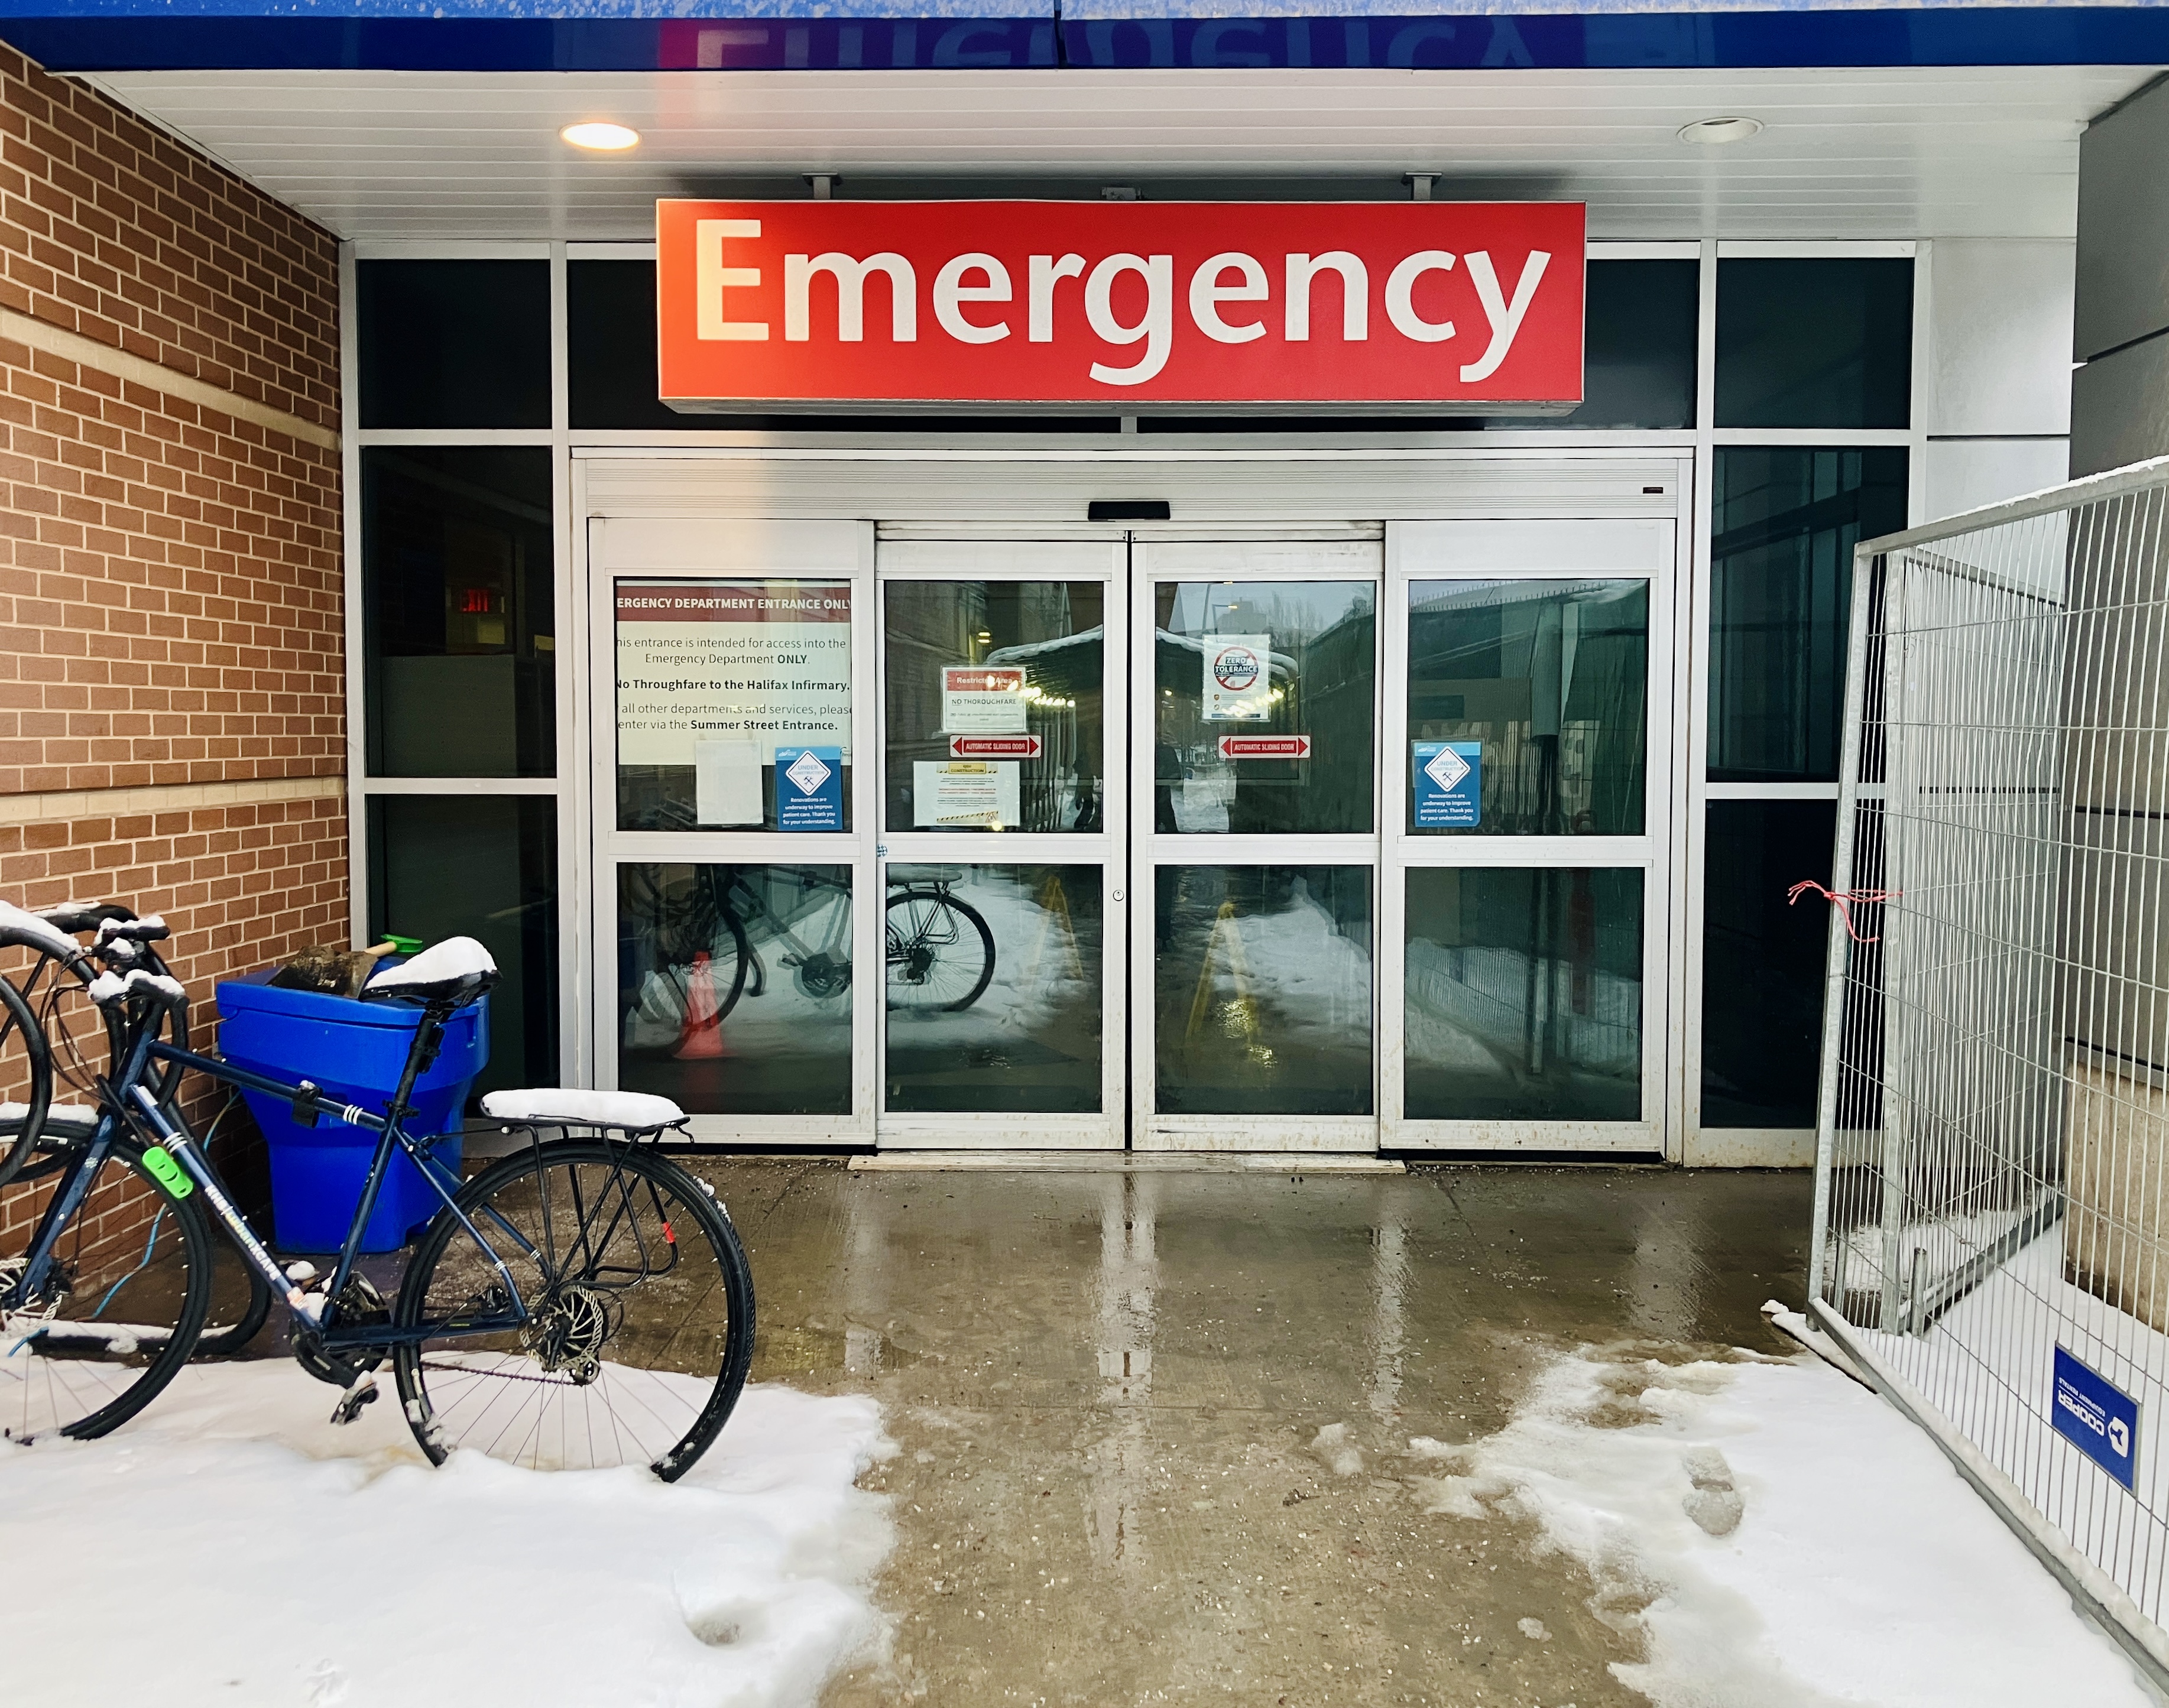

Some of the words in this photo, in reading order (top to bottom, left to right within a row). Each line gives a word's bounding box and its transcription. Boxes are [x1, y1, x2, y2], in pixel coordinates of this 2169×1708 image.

[696, 217, 1552, 386] Emergency
[617, 598, 672, 608] ERGENCY
[675, 598, 755, 609] DEPARTMENT
[757, 599, 821, 609] ENTRANCE
[617, 637, 631, 648] his
[634, 638, 682, 648] entrance
[685, 638, 694, 648] is
[697, 638, 745, 648] intended
[749, 638, 764, 648] for
[766, 639, 801, 648] access
[804, 638, 825, 648] into
[828, 638, 846, 648] the
[646, 654, 706, 666] Emergency
[709, 654, 774, 665] Department
[777, 654, 810, 664] ONLY.
[633, 679, 706, 691] Throughfare
[709, 680, 721, 689] to
[724, 680, 744, 690] the
[747, 680, 788, 690] Halifax
[792, 680, 850, 692] Infirmary.
[622, 703, 635, 713] all
[638, 703, 668, 714] other
[745, 704, 766, 714] and
[769, 704, 816, 716] services,
[618, 720, 647, 729] enter
[650, 719, 666, 729] via
[669, 720, 688, 729] the
[690, 720, 740, 729] Summer
[743, 720, 779, 730] Street
[783, 720, 838, 730] Entrance.
[2058, 1377, 2079, 1397] RENTALS
[2058, 1389, 2105, 1436] COOPER
